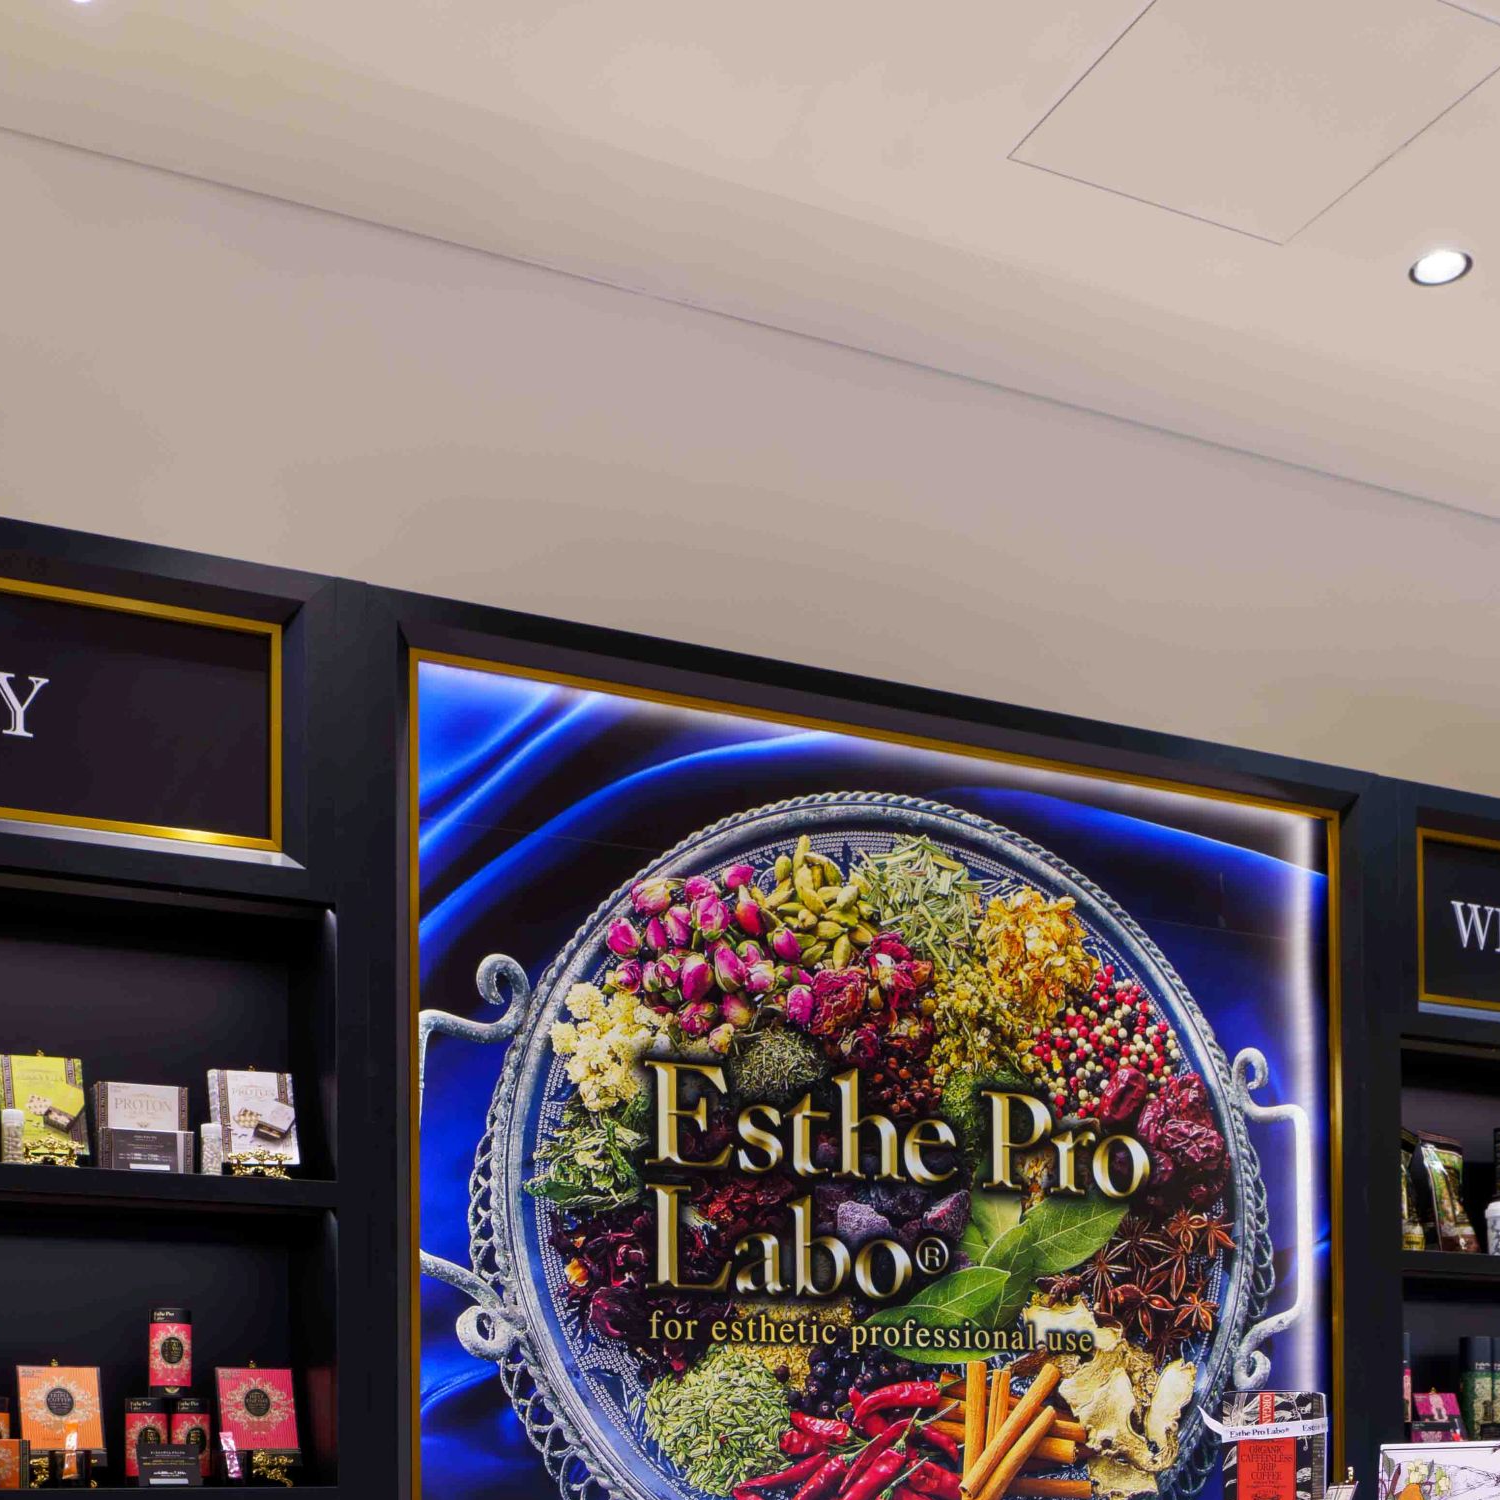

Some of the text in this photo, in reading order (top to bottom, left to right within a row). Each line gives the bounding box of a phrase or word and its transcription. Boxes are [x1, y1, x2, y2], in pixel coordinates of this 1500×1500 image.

[113, 1096, 173, 1113] PROTON
[643, 1059, 1151, 1199] Esthe Pro
[644, 1182, 951, 1301] Labo®
[648, 1309, 1092, 1354] for esthetic professional use
[1249, 1445, 1285, 1455] ORGANIC
[1256, 1463, 1276, 1472] DRIP
[1250, 1472, 1282, 1481] COFFEE
